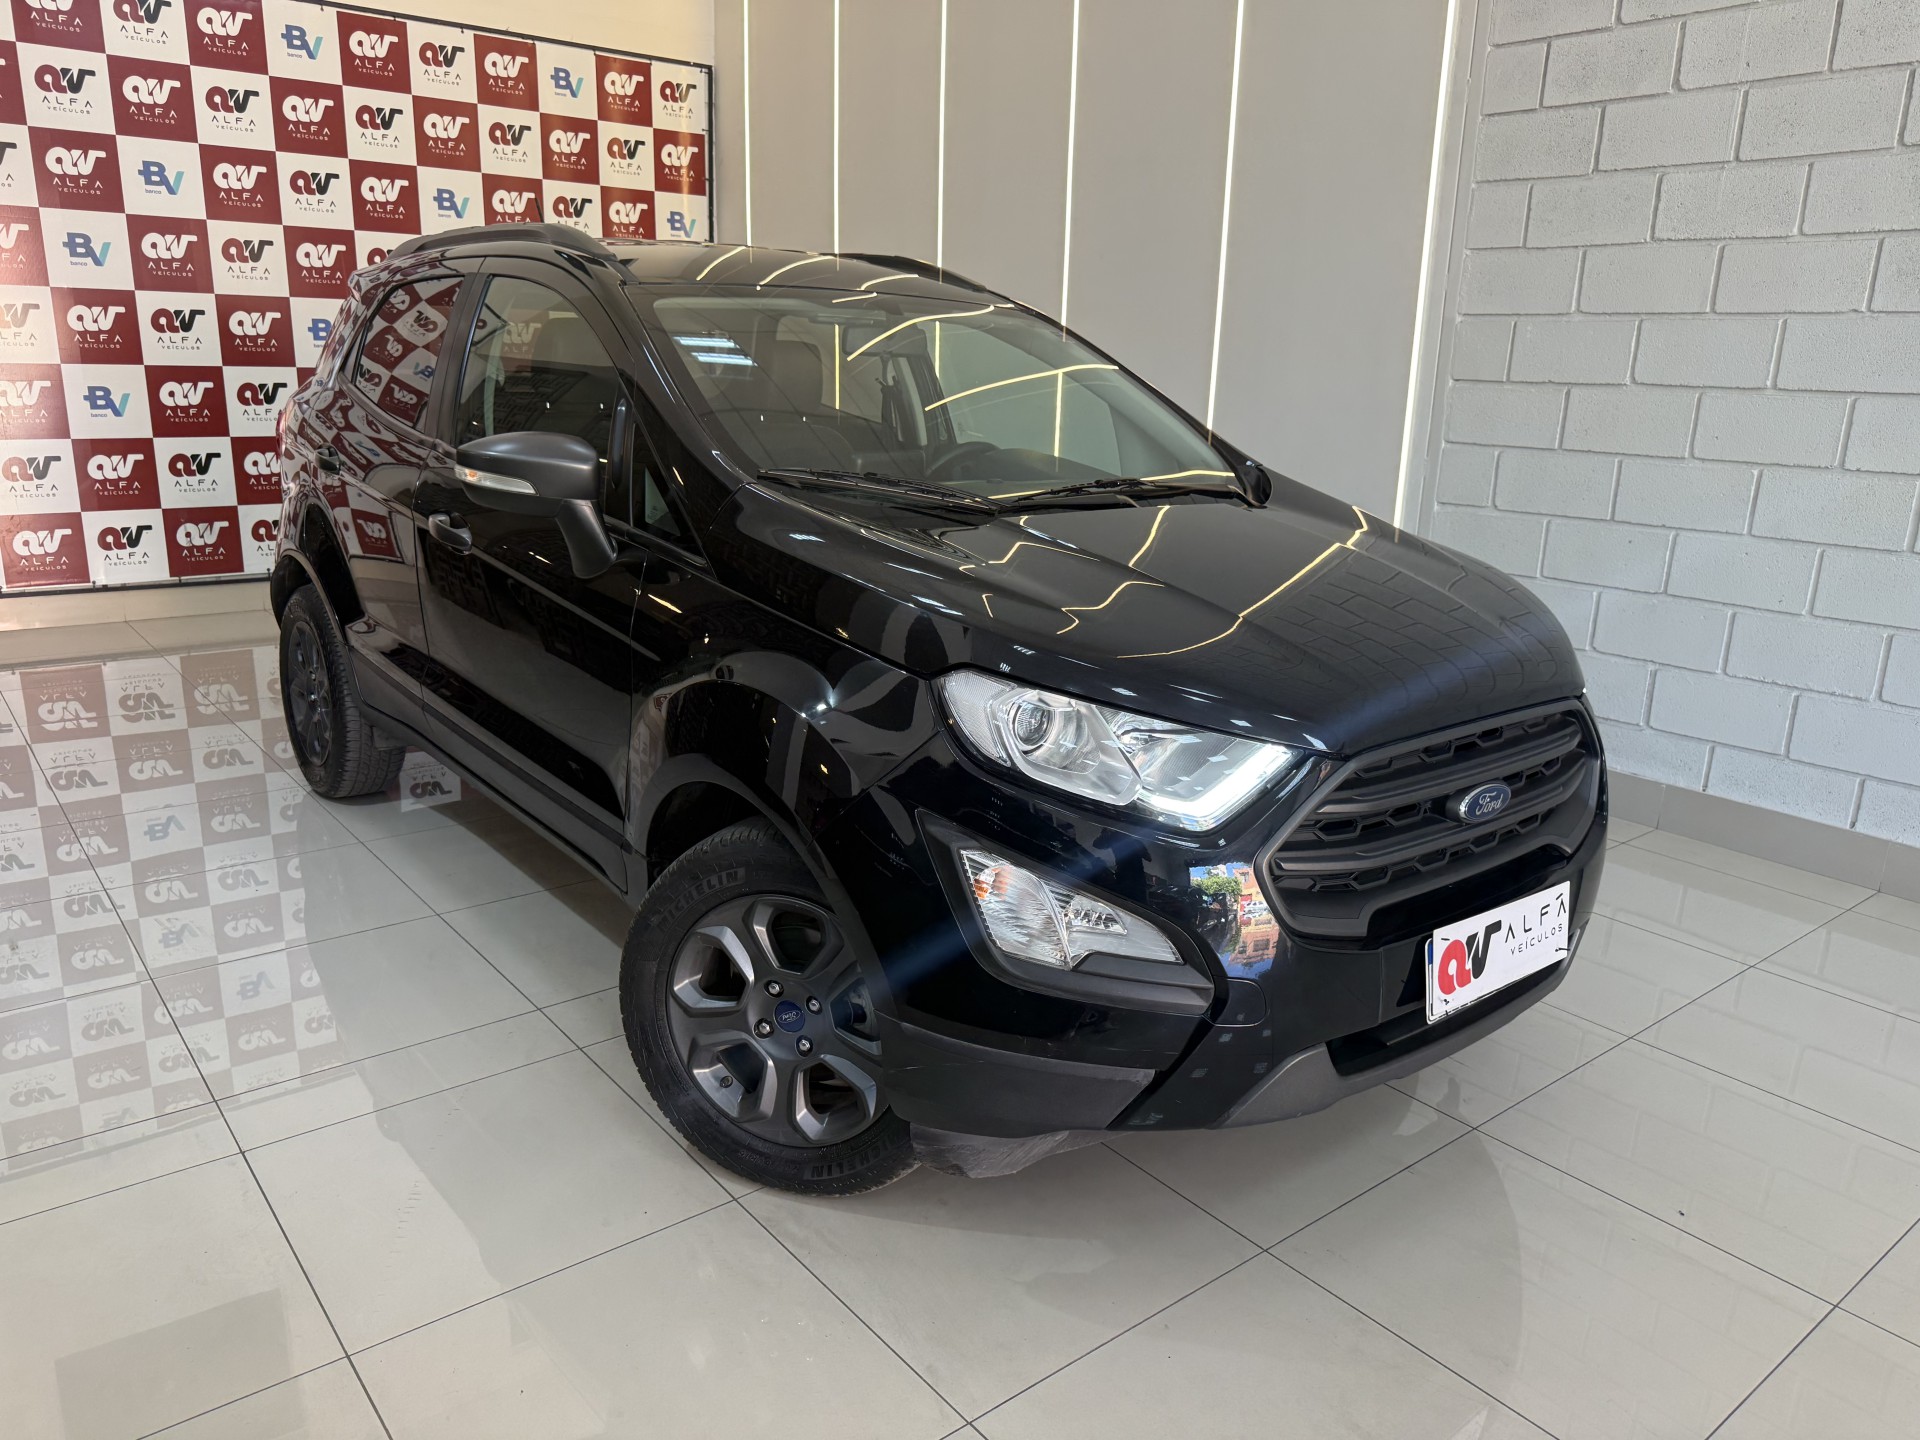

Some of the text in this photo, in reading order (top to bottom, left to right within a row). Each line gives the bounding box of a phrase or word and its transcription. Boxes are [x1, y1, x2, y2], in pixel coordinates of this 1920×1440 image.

[31, 11, 83, 26] ALFA
[120, 25, 169, 38] ALFA
[203, 37, 249, 50] ALFA
[281, 24, 323, 60] BV
[355, 60, 395, 71] ALFA
[424, 69, 462, 80] ALFA
[489, 78, 525, 90] ALFA
[550, 67, 584, 98] BV
[42, 95, 93, 109] ALFA
[608, 96, 641, 107] ALFA
[130, 105, 177, 118] ALFA
[663, 105, 694, 115] ALFA
[212, 115, 256, 127] ALFA
[288, 124, 331, 135] ALFA
[361, 133, 400, 143] ALFA
[428, 140, 466, 151] ALFA
[492, 148, 528, 158] ALFA
[553, 154, 587, 165] ALFA
[610, 161, 643, 171] ALFA
[138, 160, 184, 195] BV
[664, 168, 695, 177] ALFA
[53, 177, 103, 189] ALFA
[219, 191, 264, 202] ALFA
[295, 198, 336, 207] ALFA
[433, 188, 470, 219] BV
[366, 204, 405, 214] ALFA
[496, 215, 531, 223] ALFA
[612, 225, 645, 234] ALFA
[667, 211, 697, 238] BV
[62, 232, 112, 267] BV
[2, 253, 26, 262] FA
[148, 262, 195, 271] ALFA
[227, 266, 271, 275] ALFA
[301, 270, 343, 279] ALFA
[308, 318, 332, 342] B
[0, 332, 37, 341] LFA
[74, 333, 123, 342] ALFA
[157, 336, 203, 344] ALFA
[234, 338, 278, 346] ALFA
[83, 386, 131, 417] BV
[0, 409, 48, 417] ALFA
[166, 409, 211, 417] ALFA
[94, 480, 141, 489] ALFA
[174, 479, 218, 487] ALFA
[250, 477, 279, 485] ALF
[9, 484, 58, 492] ALFA
[104, 552, 150, 561] ALFA
[182, 547, 226, 556] ALFA
[20, 556, 69, 566] ALFA
[1476, 792, 1503, 815] Ford
[1505, 898, 1566, 943] ALFA
[1510, 923, 1563, 955] VEÍCULOS
